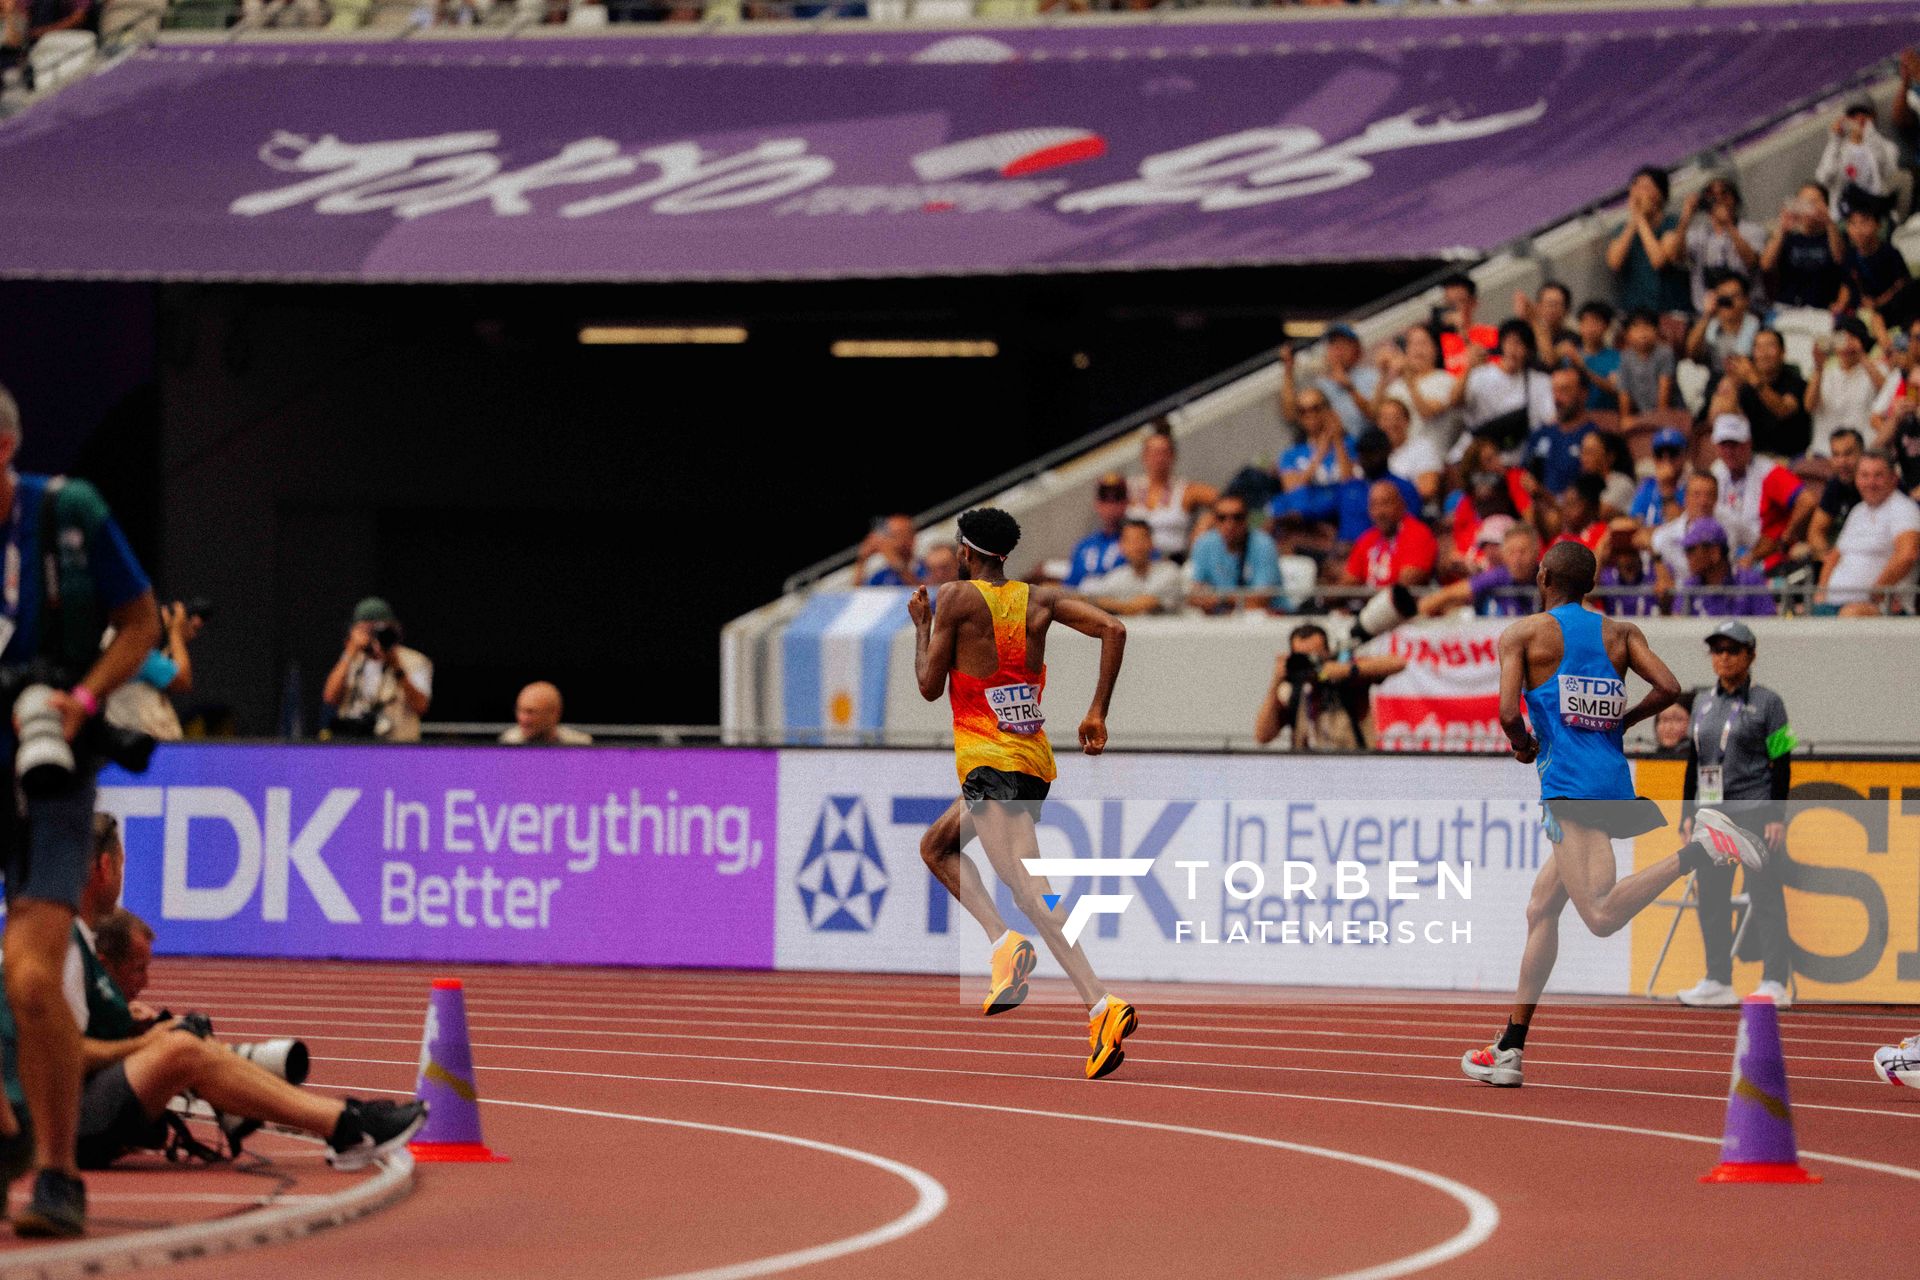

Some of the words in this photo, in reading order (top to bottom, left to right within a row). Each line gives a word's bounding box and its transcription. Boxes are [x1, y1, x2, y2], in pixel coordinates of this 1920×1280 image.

[1568, 696, 1623, 718] SIMBU
[1578, 678, 1625, 697] TDK
[382, 788, 431, 853] In
[444, 788, 764, 875] Everything,
[1221, 801, 1267, 865] In
[380, 861, 562, 930] Better
